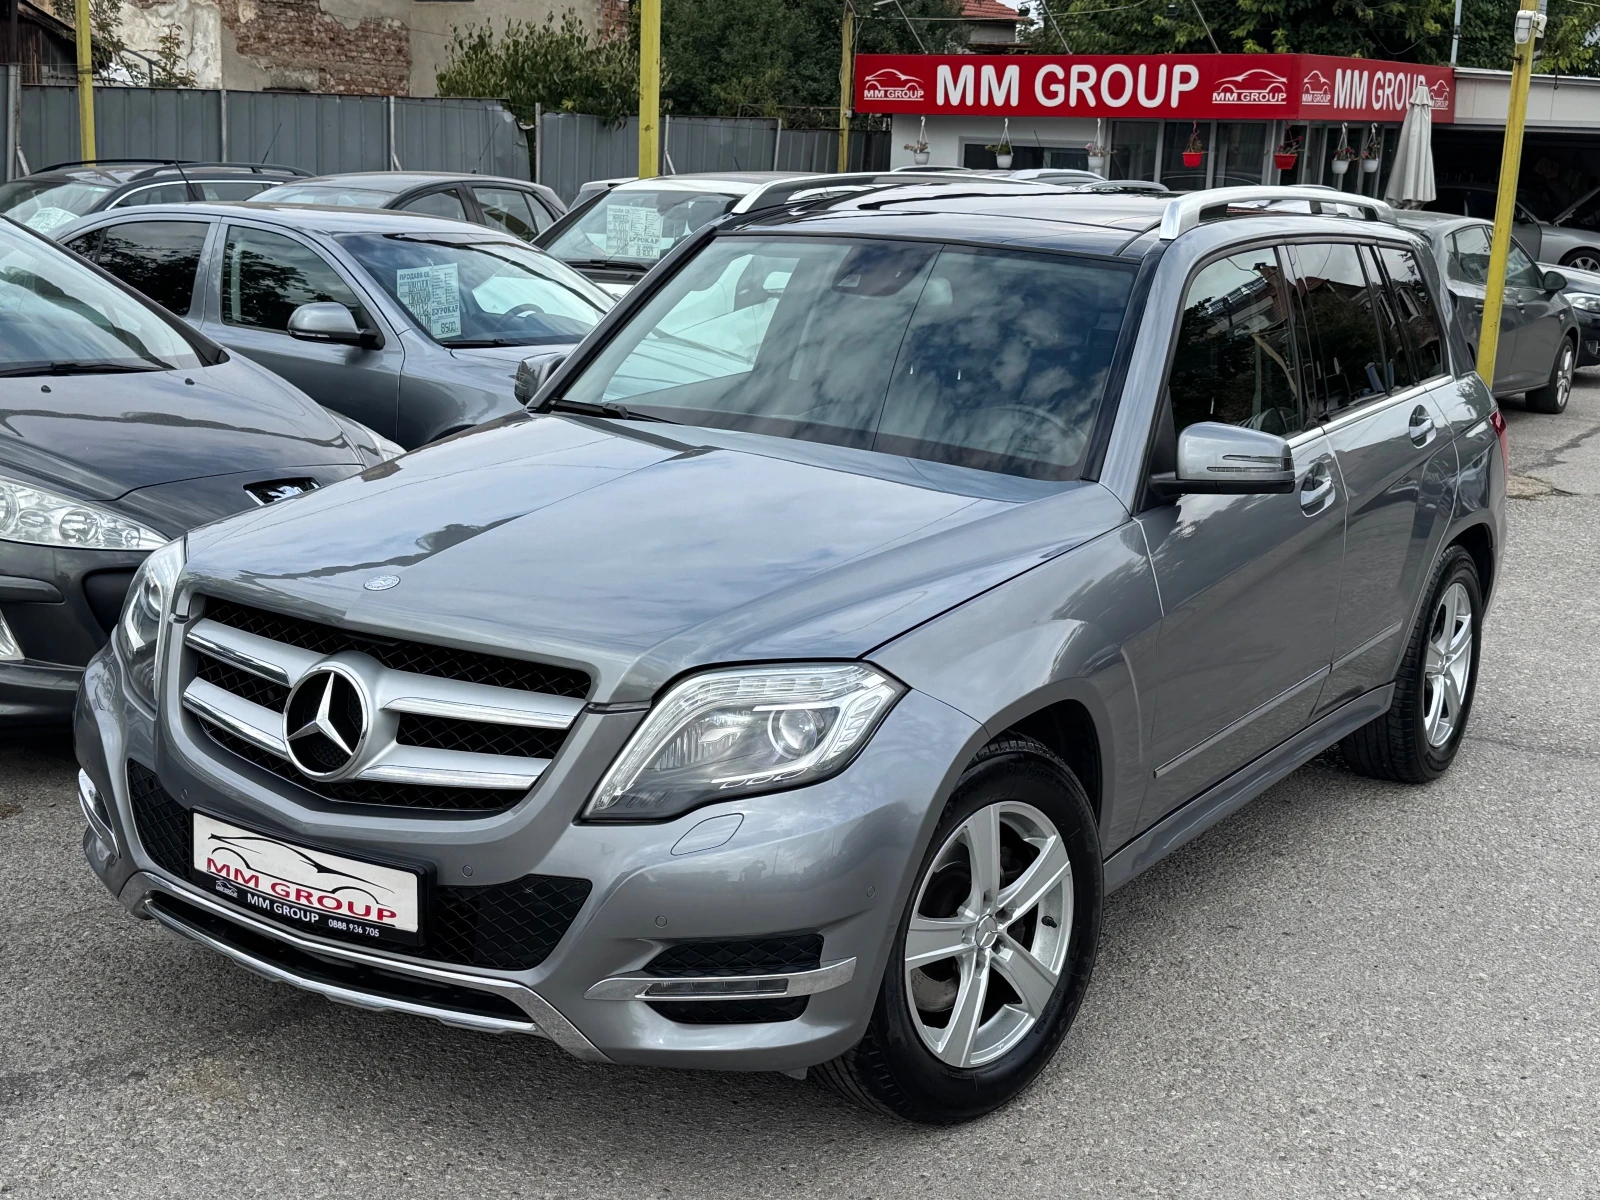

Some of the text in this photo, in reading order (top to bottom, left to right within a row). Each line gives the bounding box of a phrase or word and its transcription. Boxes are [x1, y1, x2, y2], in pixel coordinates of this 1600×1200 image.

[863, 90, 924, 99] MM GROUP
[936, 63, 1199, 108] MM GROUP
[1212, 92, 1287, 102] MM GROUP
[1302, 94, 1331, 103] MM GROUP
[1333, 68, 1369, 110] MM
[206, 857, 398, 922] MM GROUP
[247, 893, 380, 937] MM GROUP 0888 936 705
